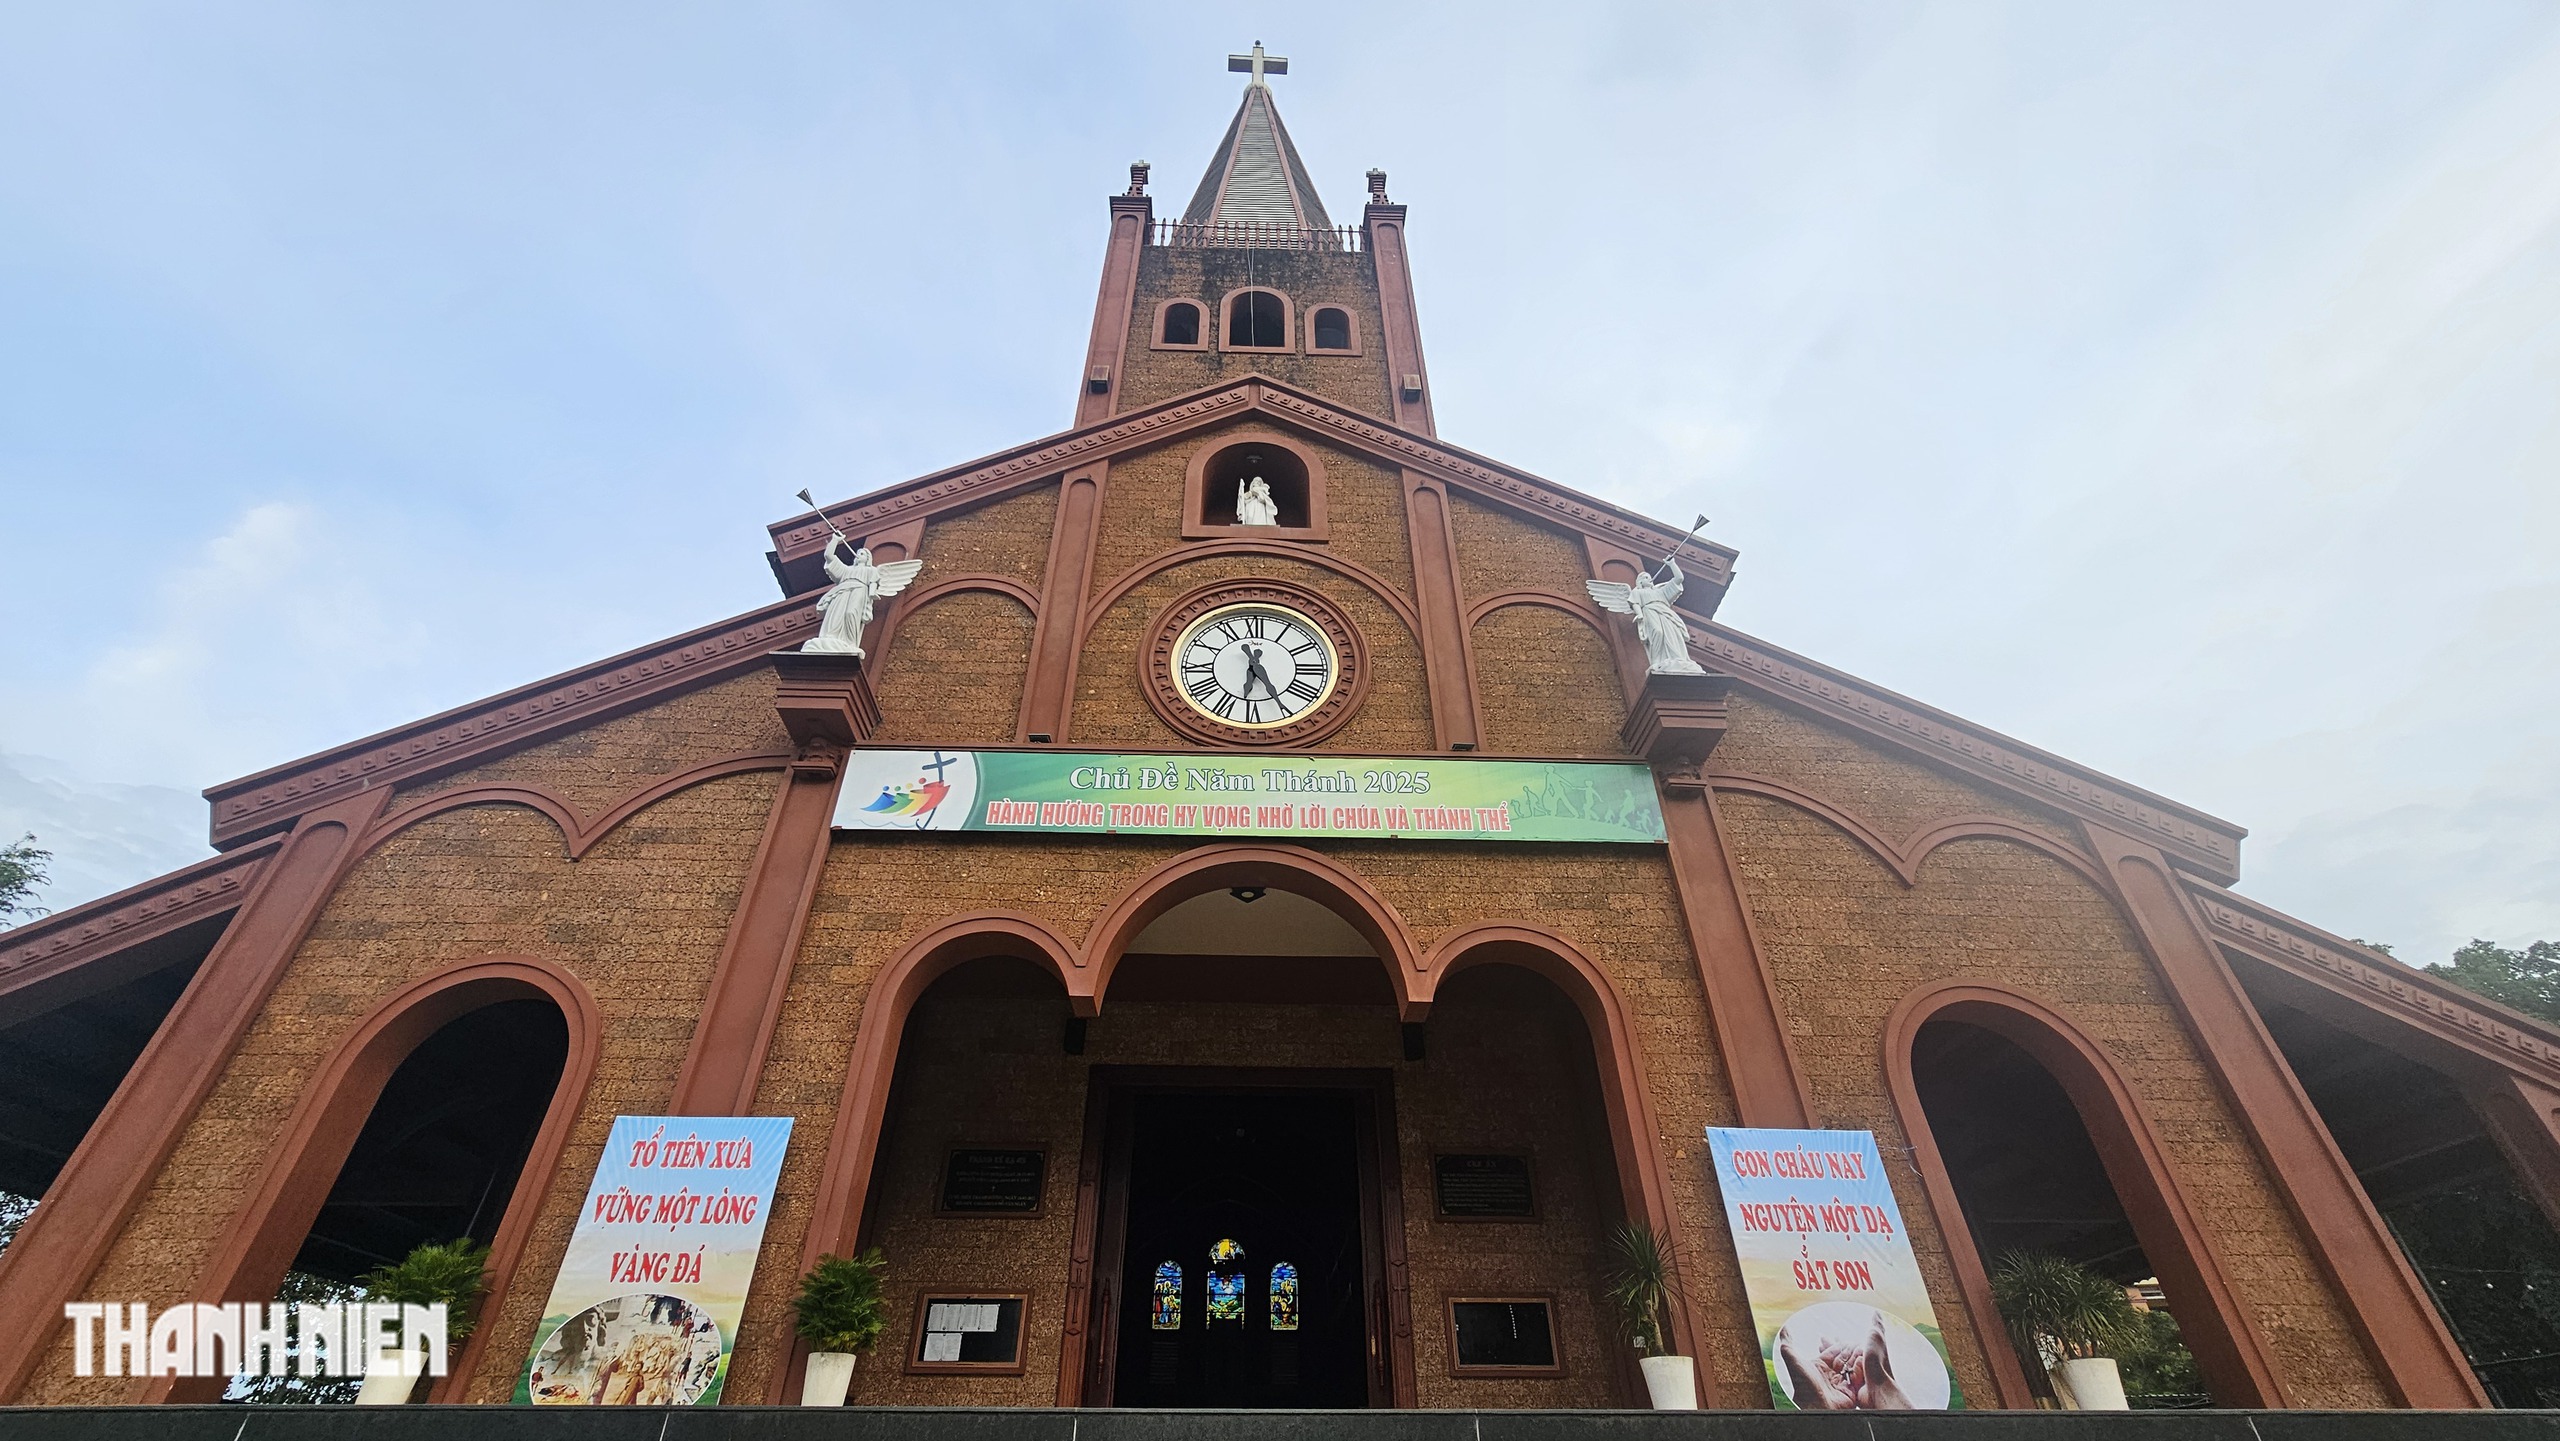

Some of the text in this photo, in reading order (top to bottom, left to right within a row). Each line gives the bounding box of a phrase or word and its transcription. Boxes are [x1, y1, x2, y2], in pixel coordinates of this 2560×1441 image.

[1069, 761, 1430, 794] Chủ Đề Năm Thánh 2025
[986, 798, 1512, 833] HÀNH HƯƠNG TRONG HY VỌNG NHỜ LỜI CHÚA VÀ THÁNH THỂ
[629, 1125, 753, 1168] TỔ TIÊN XƯA
[1733, 1144, 1867, 1180] CON CHÁU NAY
[593, 1186, 758, 1232] VỮNG MỘT LÒNG
[1739, 1197, 1894, 1242] NGUYỆN MỘT DẠ
[610, 1244, 706, 1284] VÀNG ĐÁ
[1792, 1245, 1875, 1290] SẮT SON
